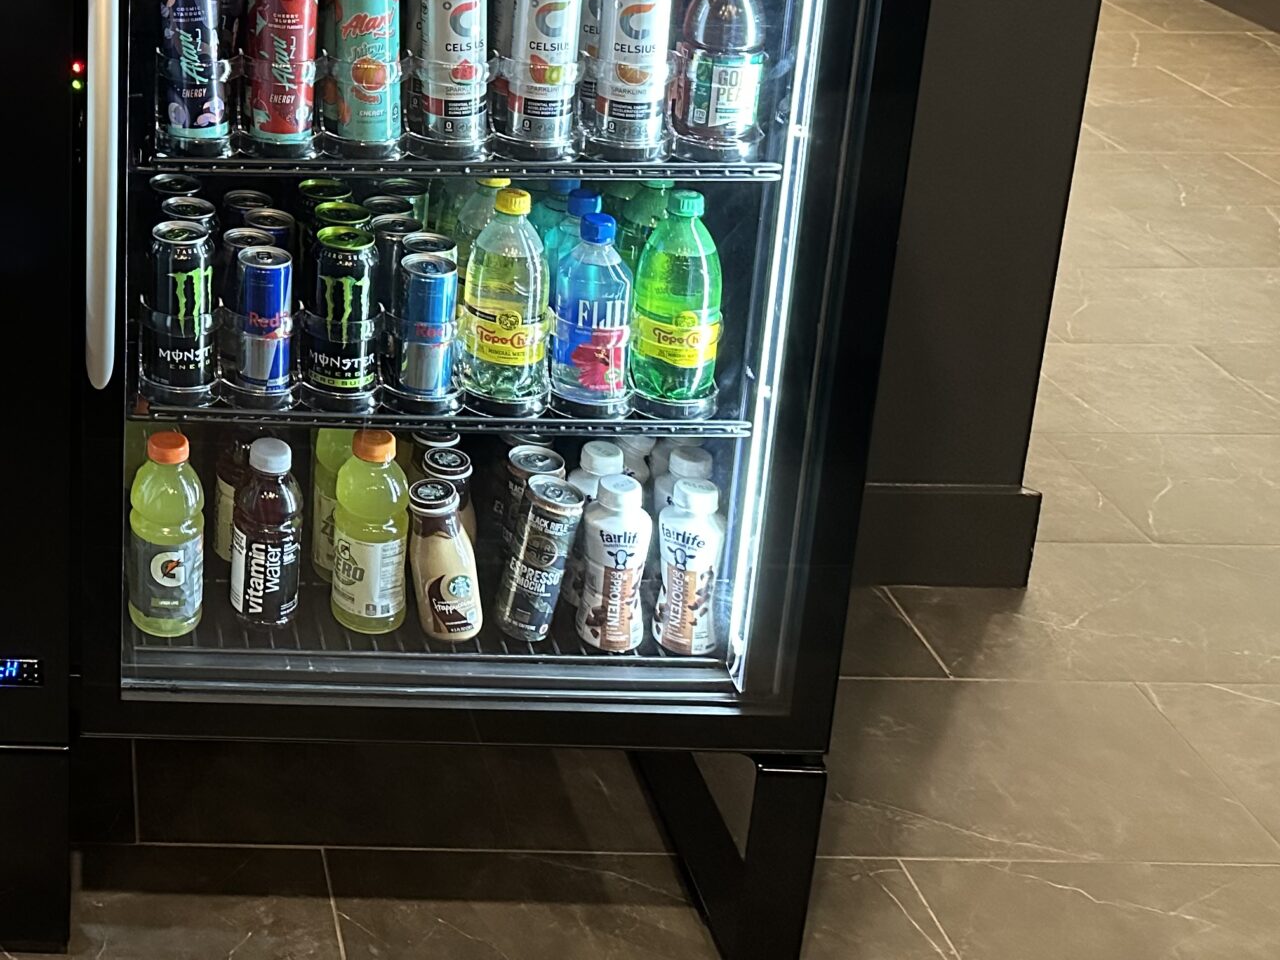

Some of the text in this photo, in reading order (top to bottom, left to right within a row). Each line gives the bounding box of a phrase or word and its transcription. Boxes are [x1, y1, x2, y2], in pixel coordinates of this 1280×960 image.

[182, 88, 207, 98] ENERGY
[270, 94, 296, 104] ENERGY
[248, 312, 280, 328] Red
[578, 300, 628, 330] FIJI
[476, 324, 508, 345] Topo
[653, 328, 685, 345] Topo
[550, 521, 570, 532] RIFLE
[150, 549, 186, 588] G
[244, 542, 266, 614] vitamin
[264, 544, 282, 592] water
[510, 556, 560, 586] ESPRESSO
[514, 576, 546, 593] MOCHA
[607, 580, 622, 624] PROTEIN
[669, 580, 684, 624] PROTEIN
